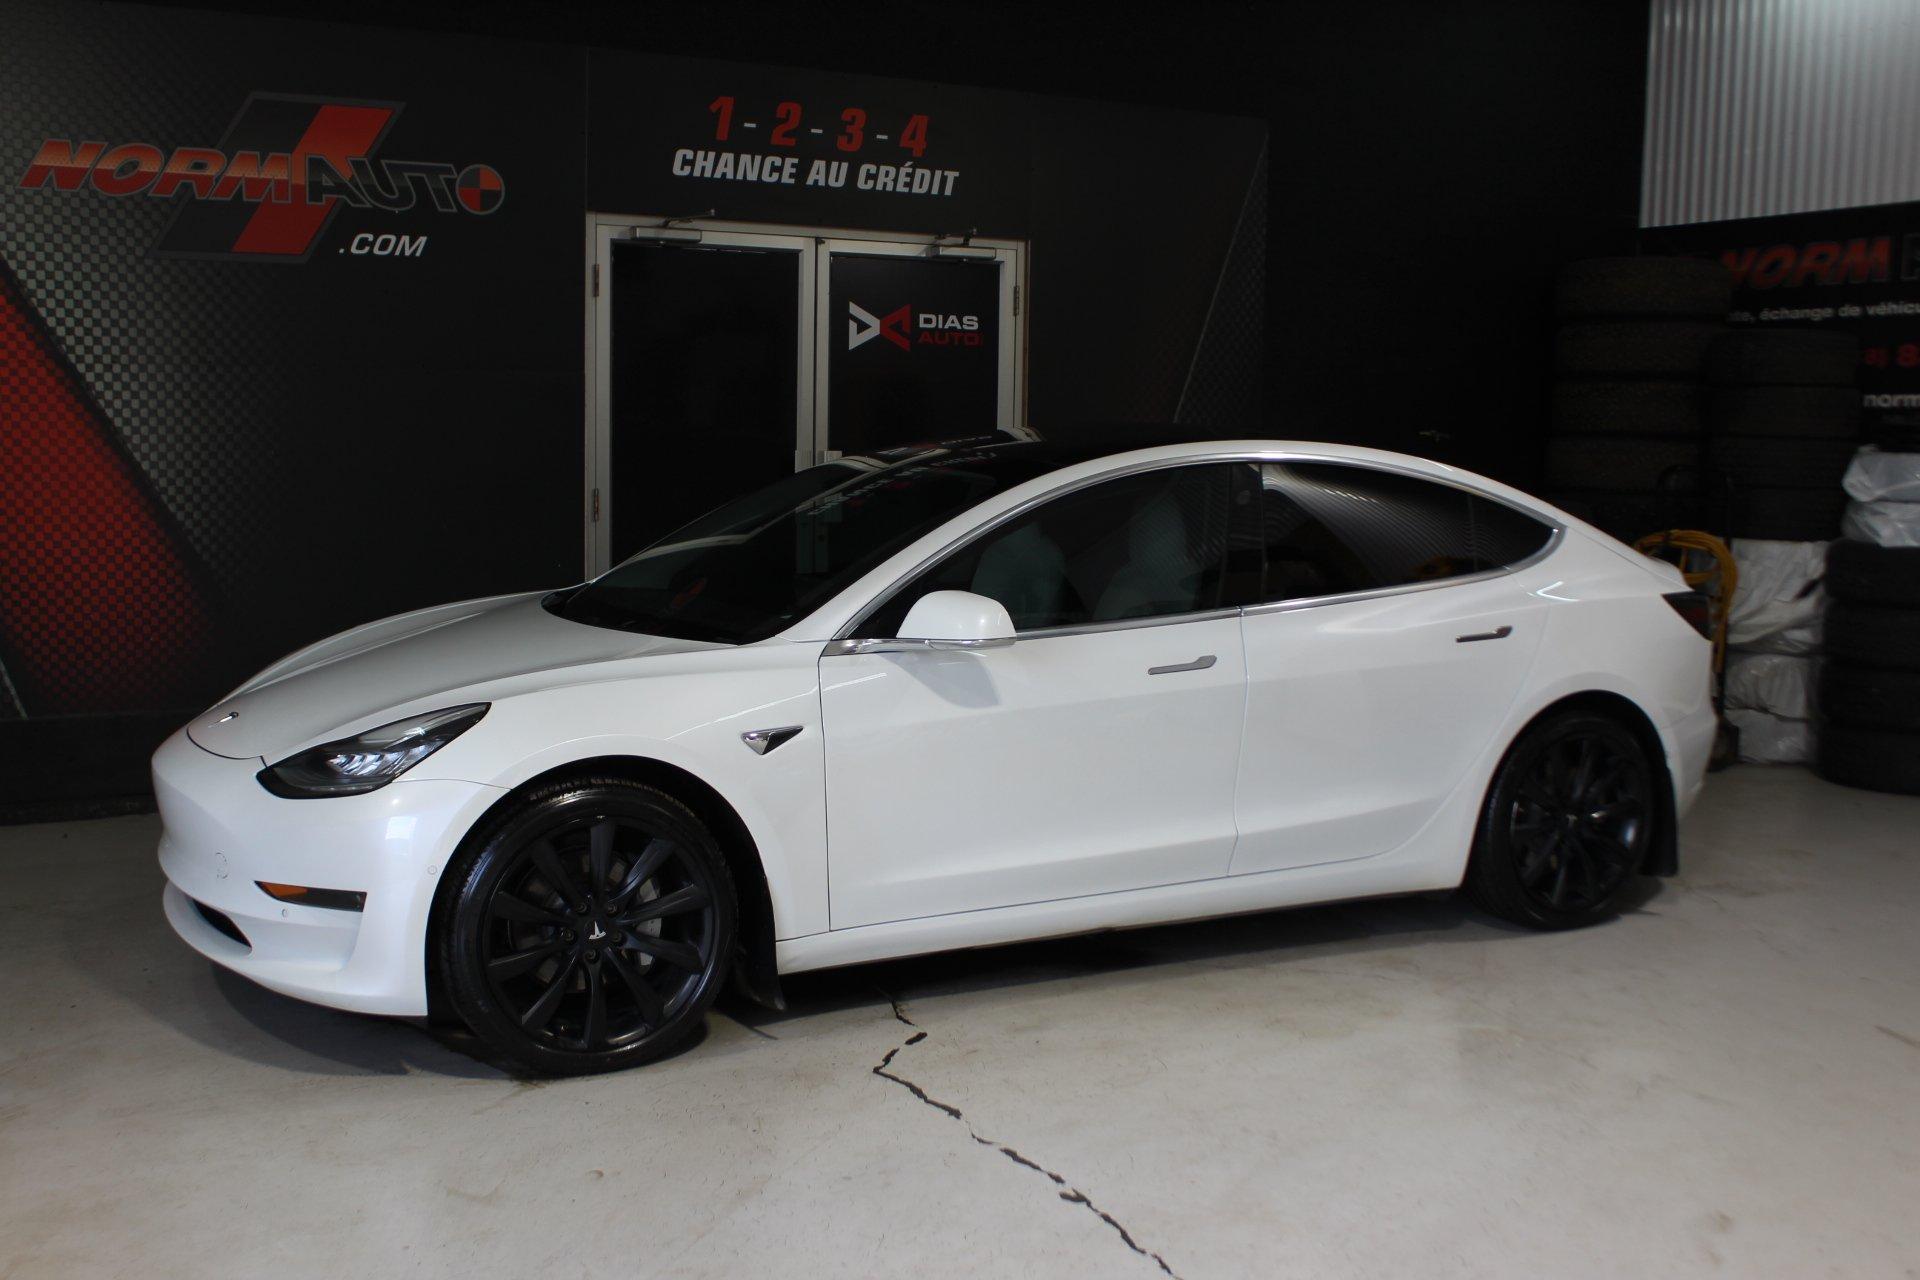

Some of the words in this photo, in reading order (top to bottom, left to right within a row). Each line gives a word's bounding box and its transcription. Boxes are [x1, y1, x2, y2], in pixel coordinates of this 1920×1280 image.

[672, 148, 799, 184] CHANCE
[806, 159, 849, 188] AU
[857, 161, 960, 196] CRÉDIT
[1838, 303, 1862, 317] de
[918, 313, 979, 331] DIAS
[918, 331, 984, 347] AUTO
